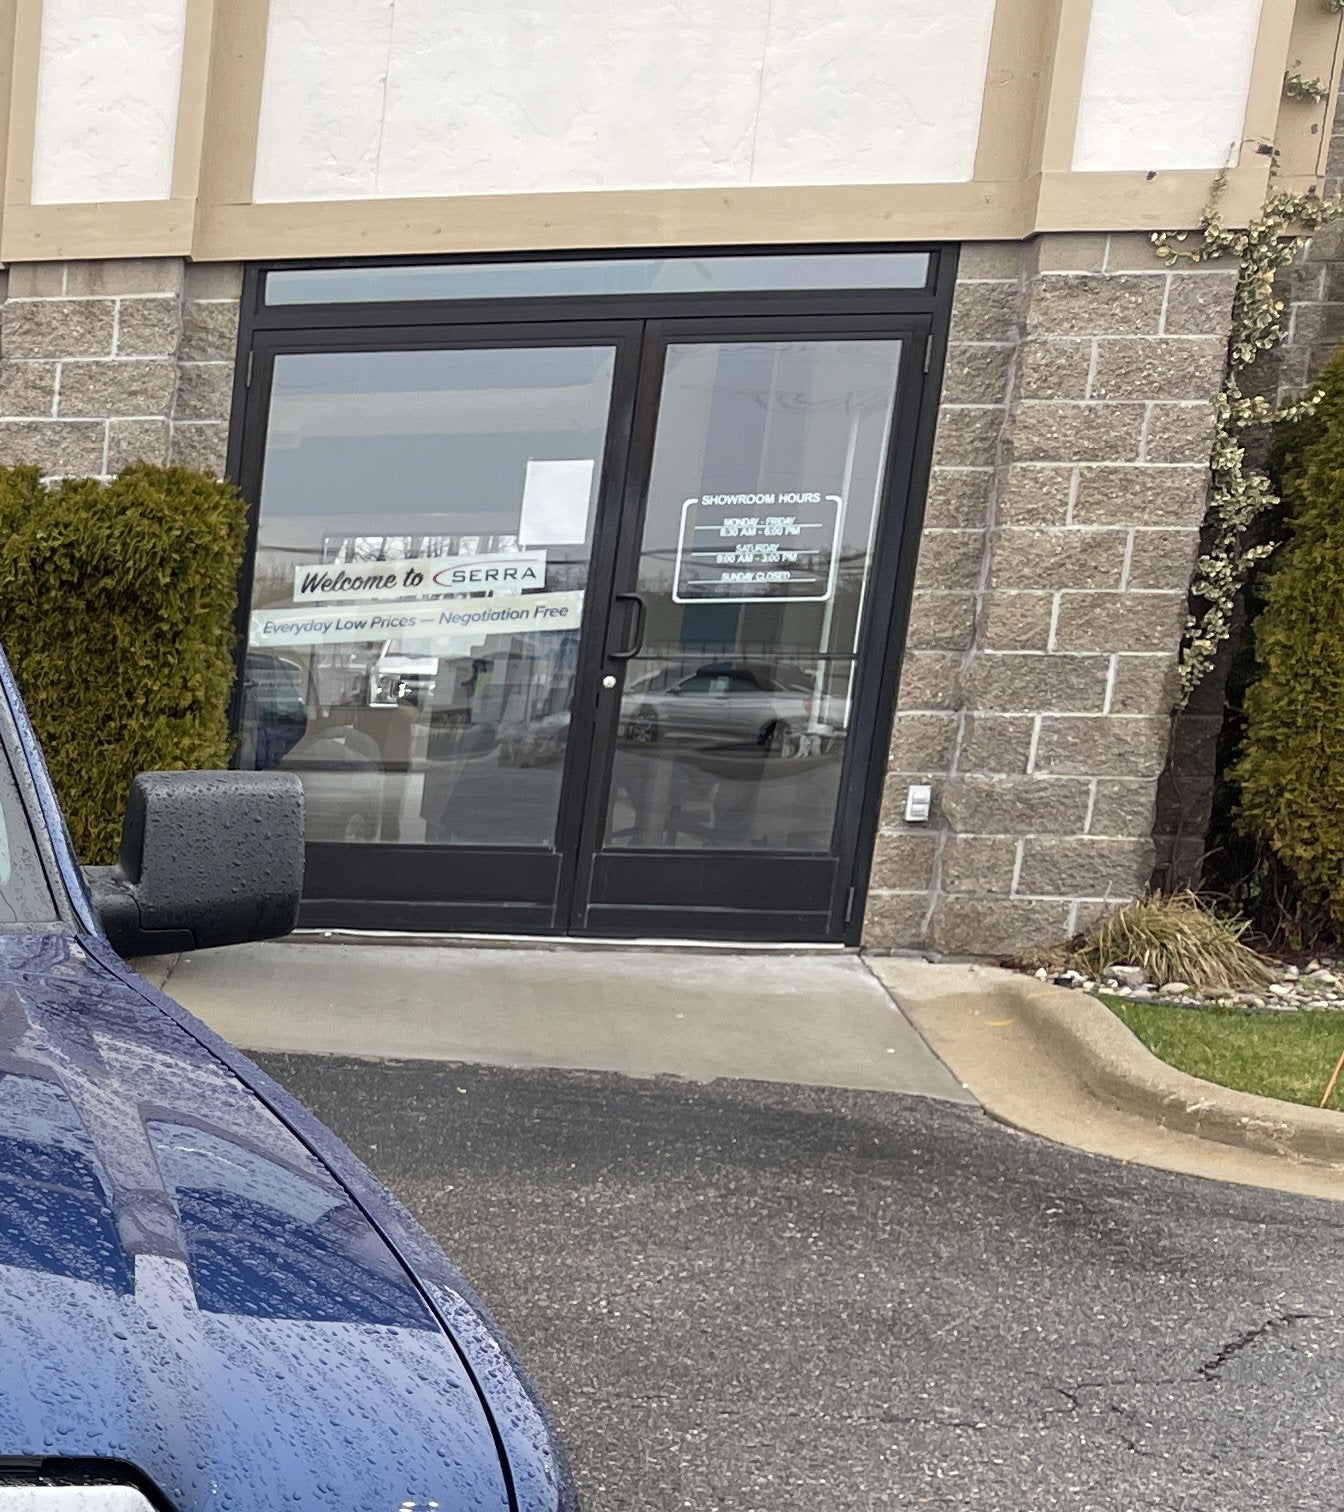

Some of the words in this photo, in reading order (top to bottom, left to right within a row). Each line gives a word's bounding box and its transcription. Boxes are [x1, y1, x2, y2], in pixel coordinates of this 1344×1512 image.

[702, 494, 775, 506] SHOWROOM
[779, 492, 821, 504] HOURS
[723, 517, 760, 527] MONDAY
[765, 516, 797, 526] FRIDAY
[739, 526, 757, 537] AM
[785, 526, 801, 536] PM
[735, 543, 780, 552] SATURDAY
[736, 553, 754, 564] AM
[781, 551, 798, 562] PM
[300, 570, 398, 595] Welcome
[403, 567, 425, 587] to
[452, 567, 537, 583] SERRA
[755, 570, 791, 581] CLOSED
[263, 621, 331, 636] Everyday
[335, 618, 367, 631] Low
[370, 614, 416, 629] Prices
[438, 609, 529, 627] Negotiation
[533, 604, 569, 619] Free
